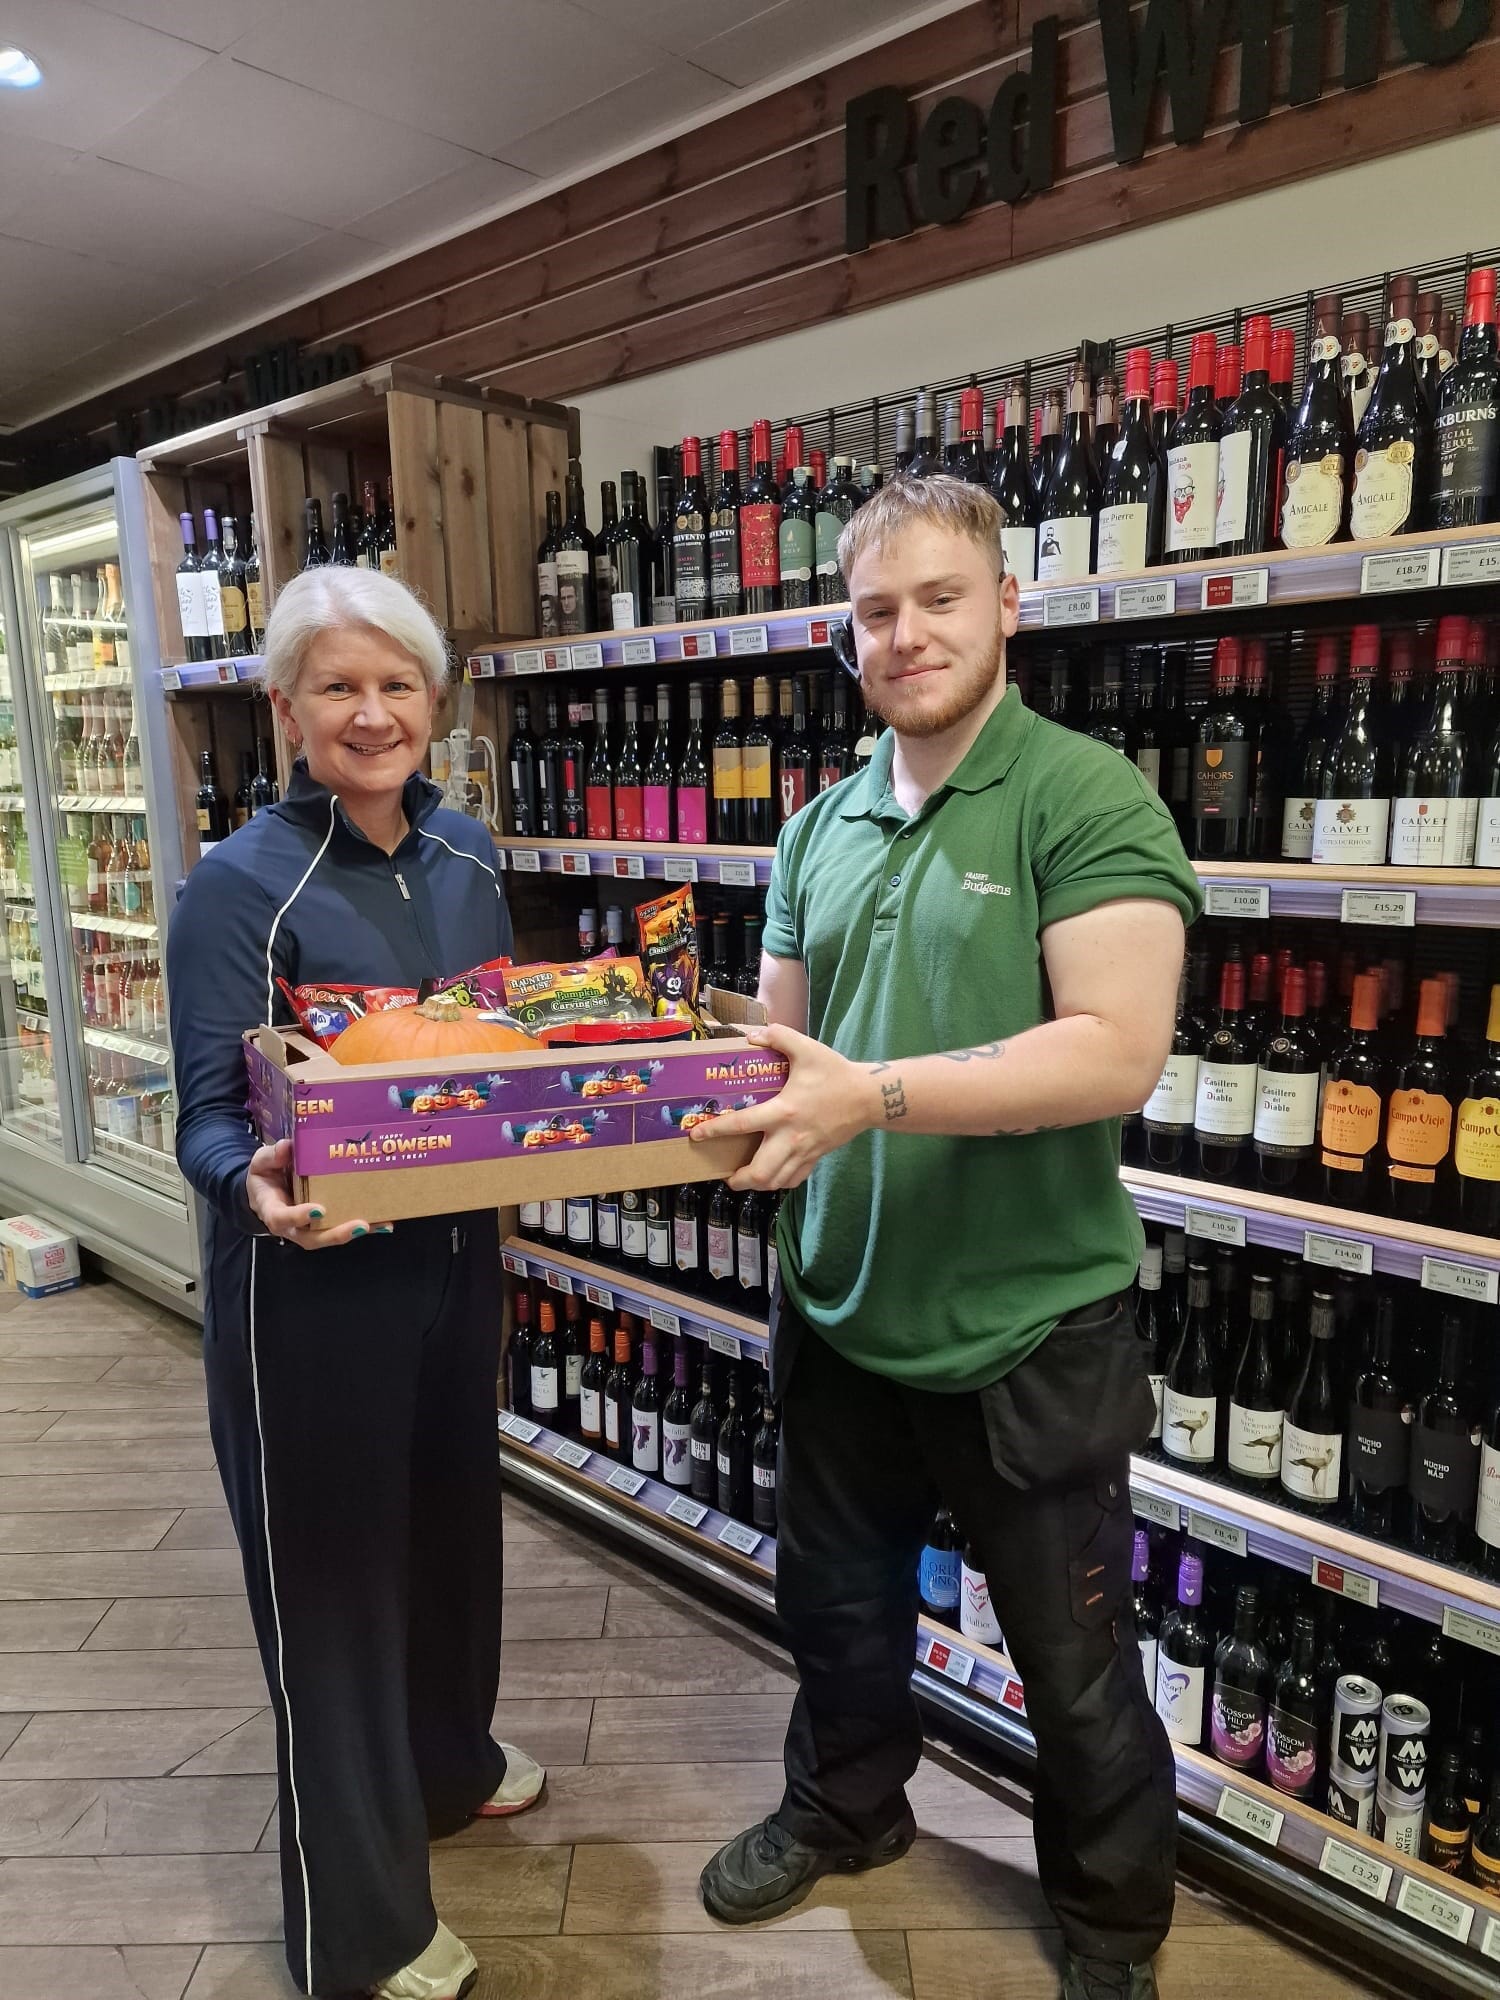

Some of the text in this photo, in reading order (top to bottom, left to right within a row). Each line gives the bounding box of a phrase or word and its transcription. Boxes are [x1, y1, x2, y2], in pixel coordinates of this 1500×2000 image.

[846, 15, 1059, 254] Red
[1358, 492, 1396, 506] AMICALE
[1289, 503, 1329, 516] AMICALE
[1396, 564, 1427, 575] £18.79
[1141, 594, 1166, 603] £10.00
[1068, 602, 1090, 612] £8.00
[1197, 771, 1234, 780] CAHORS
[1401, 817, 1449, 826] CALVET
[1322, 825, 1372, 834] CALVET
[961, 879, 1011, 896] Budgens
[1233, 897, 1260, 905] £10.00
[1374, 903, 1404, 912] £15.29
[511, 972, 554, 989] HAUNTED
[555, 988, 600, 1000] Pumpkin
[552, 998, 608, 1011] Carving Set
[526, 1008, 536, 1020] 6
[706, 1061, 789, 1081] HALLOWEE
[1204, 1077, 1238, 1088] Casillero
[1206, 1092, 1233, 1103] Diablo
[1261, 1085, 1296, 1098] Casillero
[1264, 1100, 1290, 1113] Diablo
[1348, 1104, 1373, 1117] Viejo
[1391, 1108, 1445, 1127] Campo Viejo
[1460, 1117, 1491, 1137] Campo
[329, 1134, 452, 1159] HALLOWEEN
[402, 1152, 428, 1160] TREAT
[1212, 1222, 1236, 1233] £10.50
[1335, 1248, 1362, 1260] £14.00
[1455, 1275, 1486, 1288] £11.50
[1241, 1419, 1276, 1430] SECRETARY
[694, 1440, 707, 1451] BIN
[1358, 1435, 1382, 1449] MUCHO
[1423, 1459, 1450, 1473] MUCHO
[758, 1468, 771, 1479] BIN
[758, 1477, 772, 1487] 161
[1219, 1703, 1256, 1721] BLOSSOM
[1227, 1715, 1244, 1726] HILL
[1272, 1727, 1305, 1749] BLOSSOM
[1277, 1739, 1293, 1752] HILL
[1246, 1811, 1271, 1829] £8.49
[1403, 1827, 1413, 1855] ANTED
[1351, 1864, 1379, 1884] £3.29
[1430, 1904, 1460, 1925] £3.29
